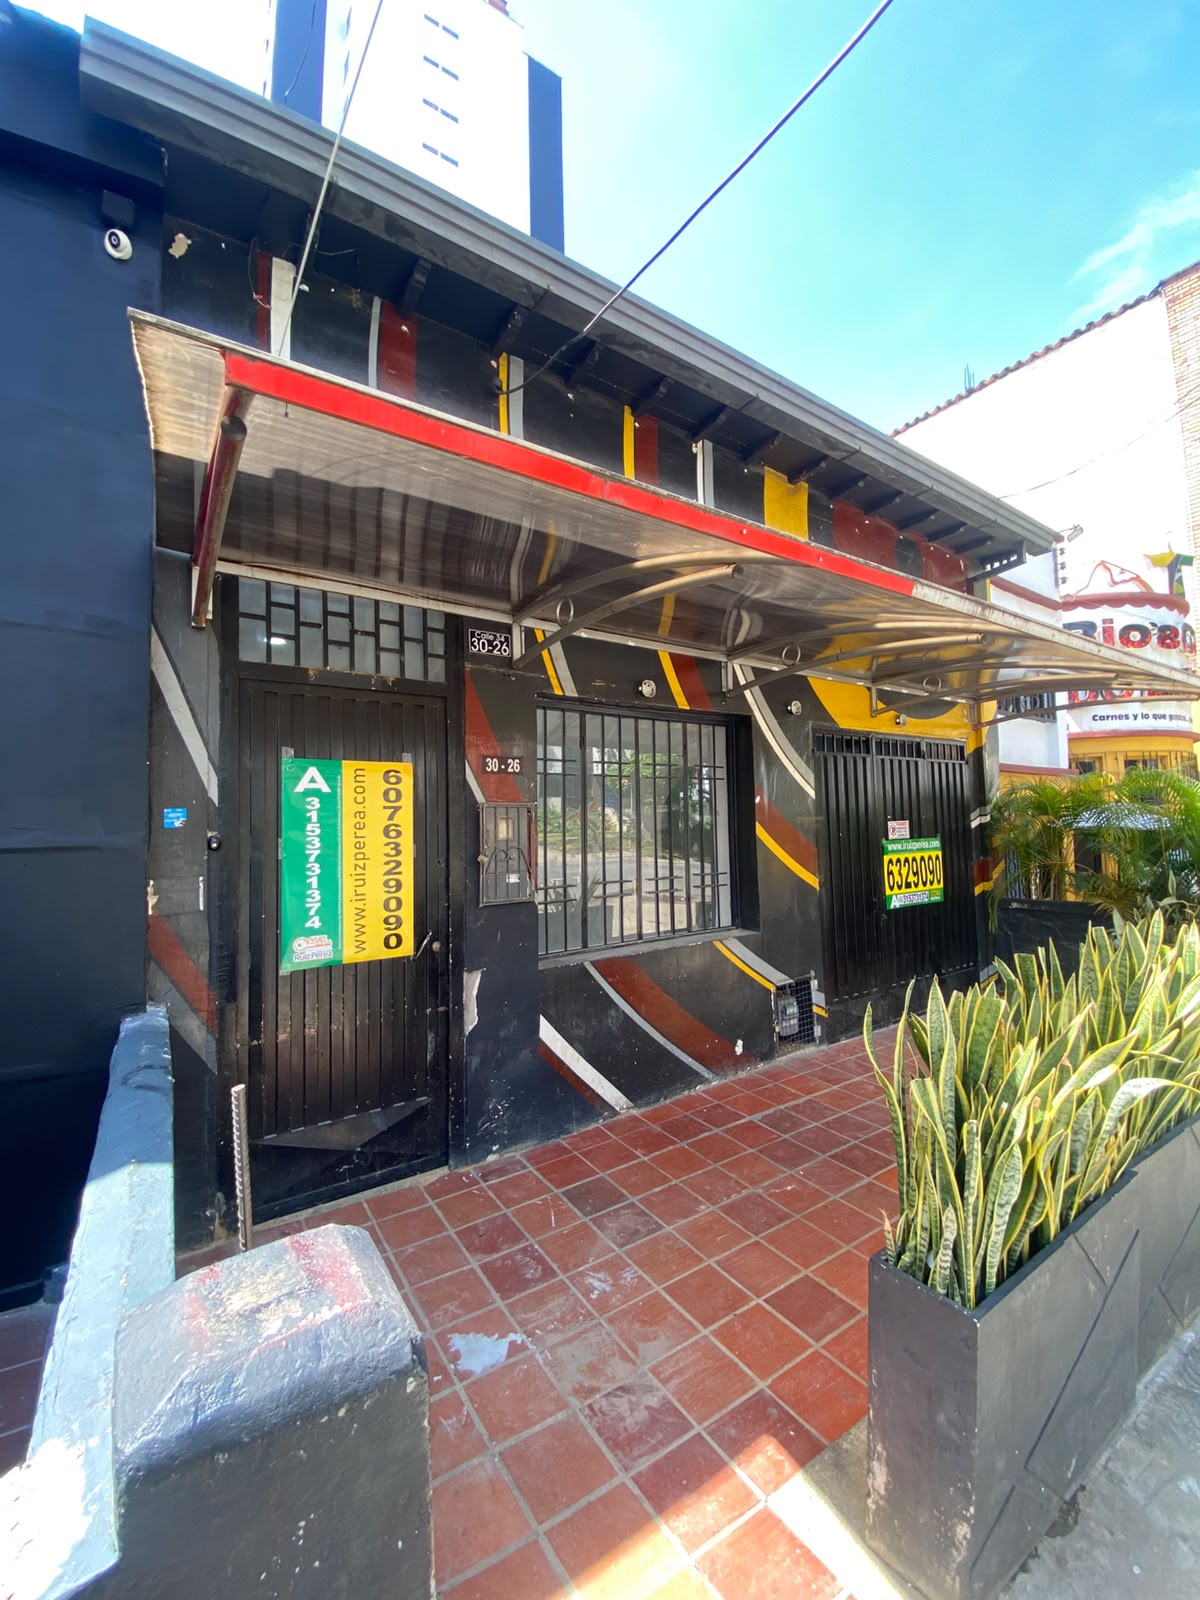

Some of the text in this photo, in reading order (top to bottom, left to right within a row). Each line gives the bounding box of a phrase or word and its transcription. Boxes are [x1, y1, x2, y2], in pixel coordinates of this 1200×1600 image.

[474, 630, 505, 642] Calle 34
[471, 637, 509, 656] 30-26
[1092, 712, 1130, 722] Carnes
[1132, 713, 1139, 721] y
[1141, 712, 1150, 720] lo
[1152, 713, 1167, 721] que
[485, 757, 499, 772] 30
[507, 758, 521, 772] 26
[293, 766, 332, 793] A
[887, 840, 941, 851] www.iruizperea.com
[350, 767, 370, 955] www.iruizperea.com
[382, 769, 403, 950] 6076329090
[886, 853, 941, 892] 6329090
[294, 951, 311, 961] Ruiz
